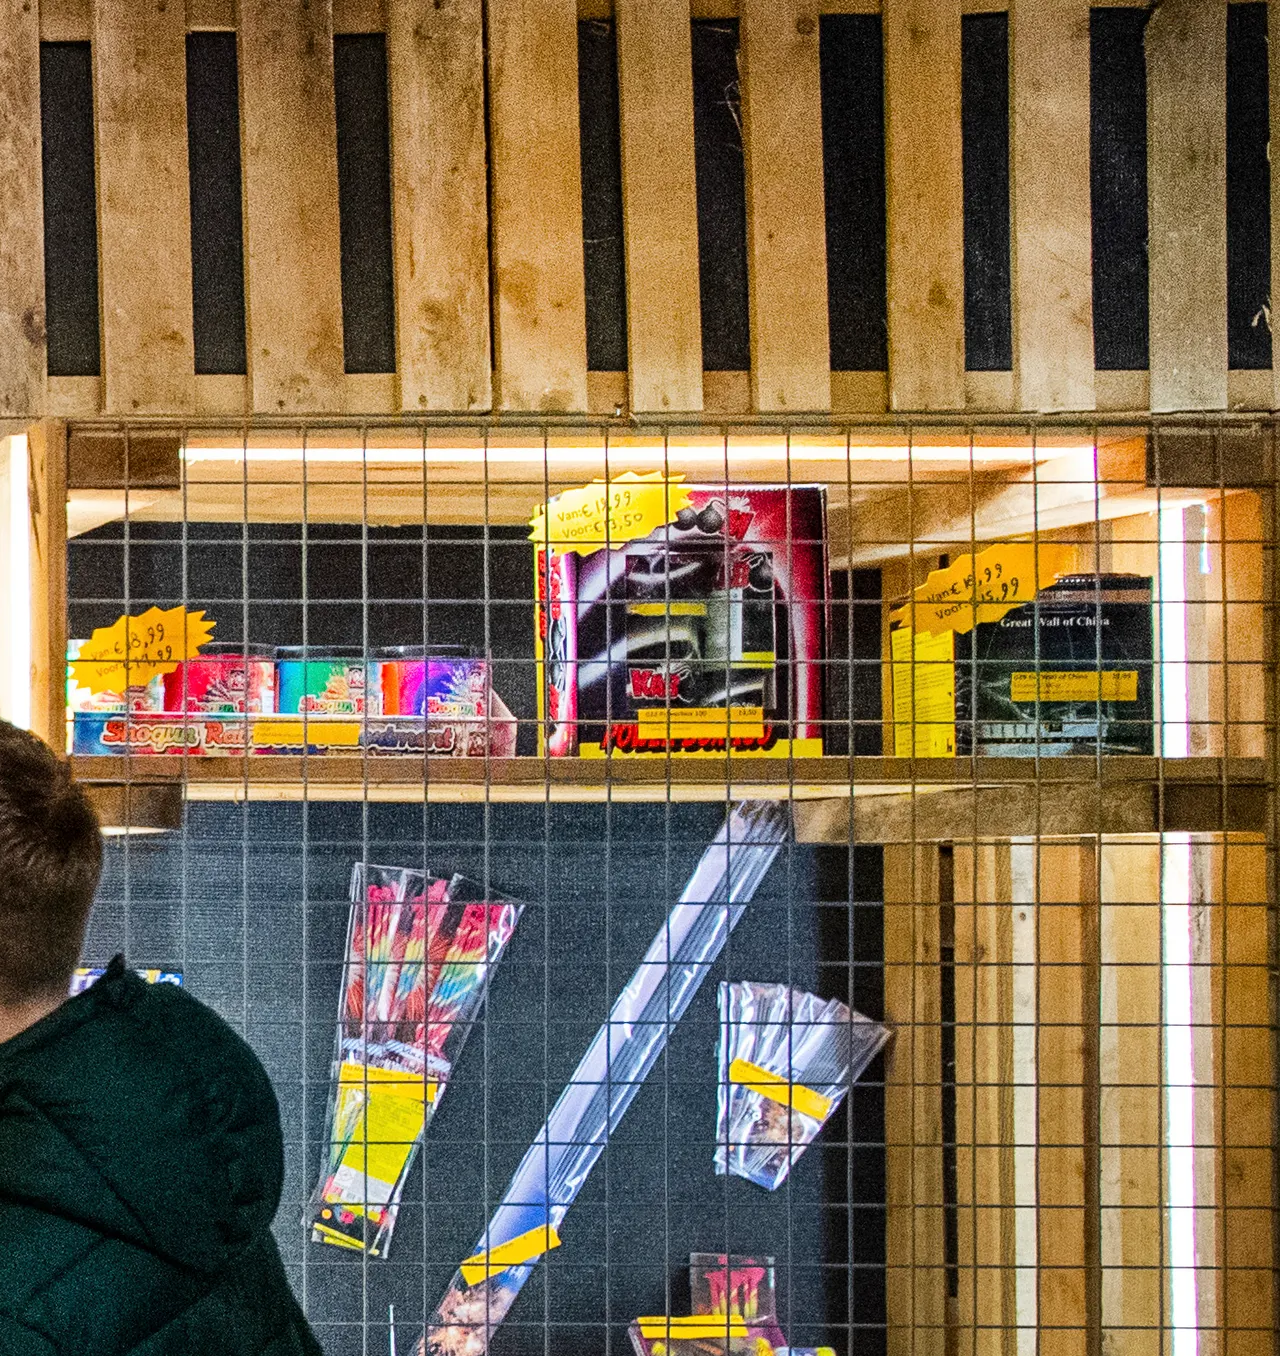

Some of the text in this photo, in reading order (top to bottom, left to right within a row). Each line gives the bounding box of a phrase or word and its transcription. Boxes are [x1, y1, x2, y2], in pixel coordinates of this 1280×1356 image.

[557, 509, 582, 522] Van:
[562, 526, 593, 539] Voor:
[1000, 617, 1032, 628] Great
[1062, 617, 1075, 627] of
[129, 623, 165, 649] 8,99
[102, 719, 197, 751] Shogun
